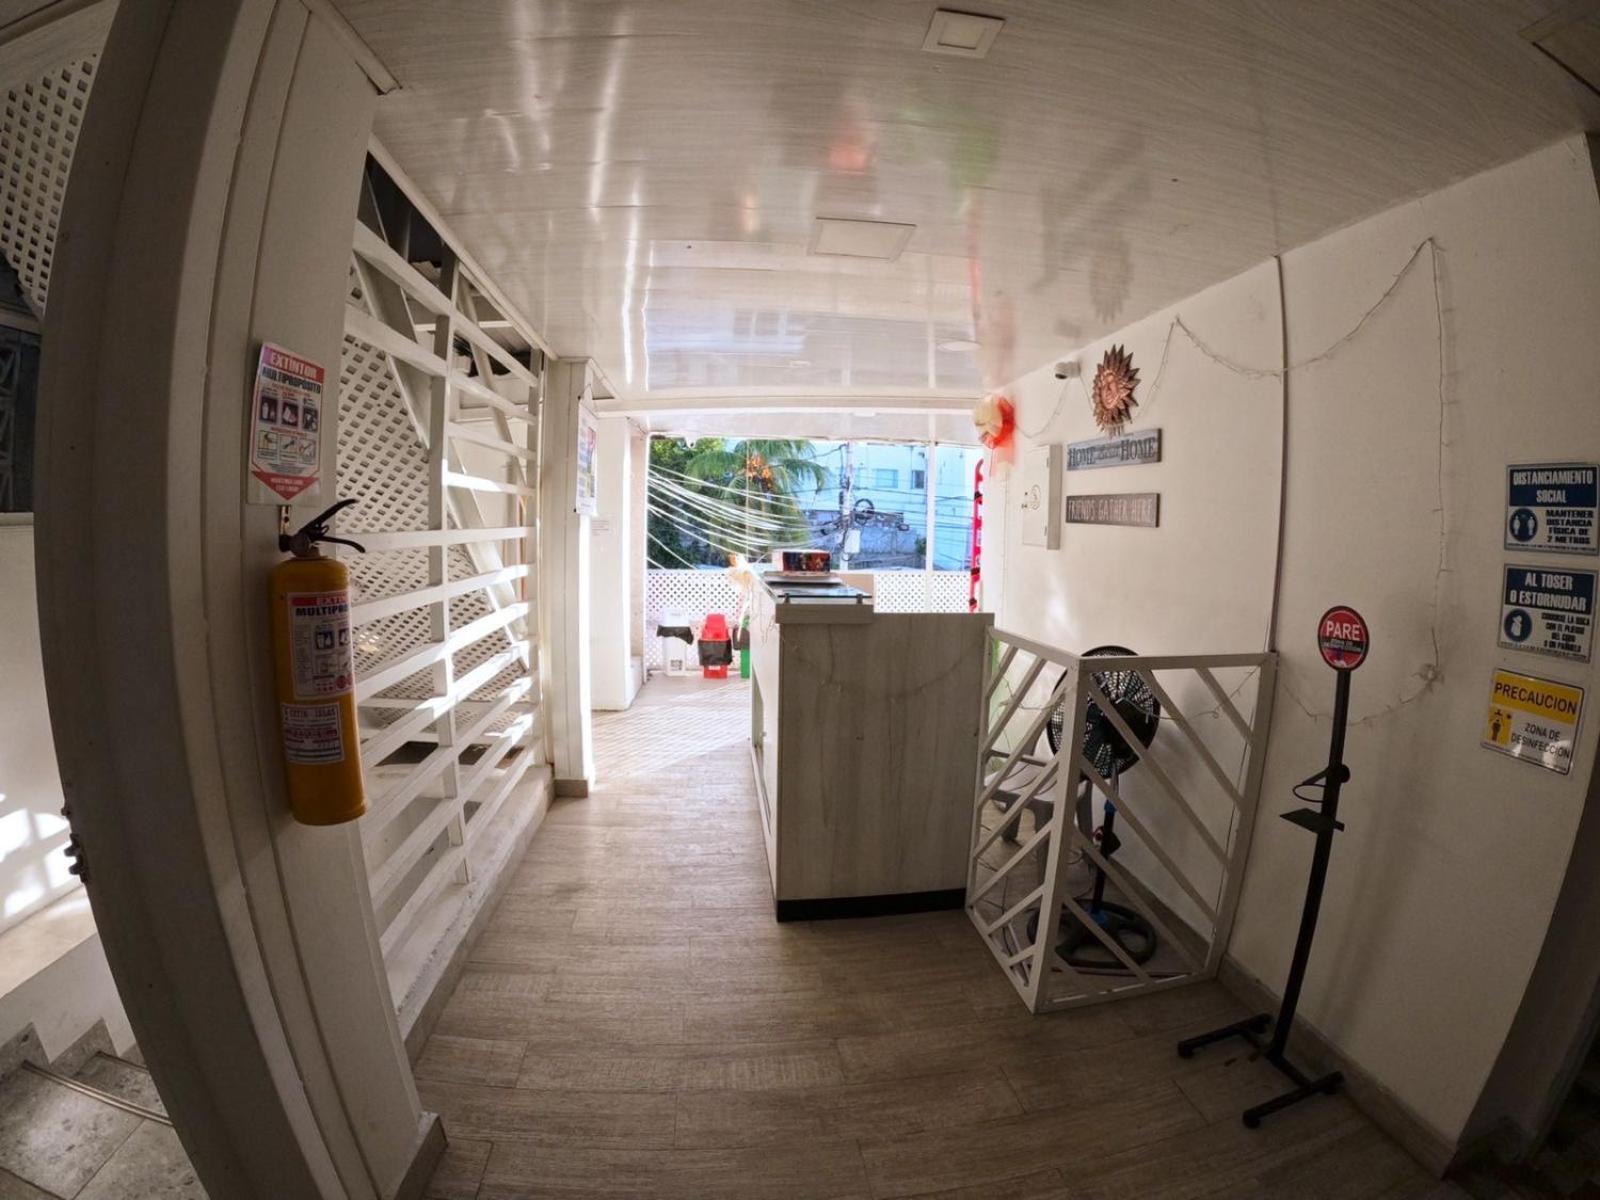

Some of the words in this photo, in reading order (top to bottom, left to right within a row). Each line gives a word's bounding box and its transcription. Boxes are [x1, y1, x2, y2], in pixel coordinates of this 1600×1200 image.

[271, 352, 317, 380] EXTINTOR
[1068, 446, 1096, 467] HOME
[1120, 437, 1156, 460] HOME
[1513, 470, 1593, 485] DISTANCIAMIENTO
[1536, 489, 1567, 504] SOCIAL
[1546, 510, 1593, 518] MANTENER
[1546, 518, 1593, 527] DISTANCIA
[1554, 535, 1591, 545] METROS
[1525, 572, 1537, 587] AL
[1541, 574, 1573, 590] TOSER
[1509, 589, 1517, 603] O
[1519, 591, 1586, 611] ESTORNUDAR
[1326, 620, 1361, 641] PARE
[1494, 682, 1578, 715] PRECAUCION
[1524, 722, 1547, 738] ZONA
[1548, 728, 1560, 741] DE
[1511, 732, 1570, 759] DESINFECCION
